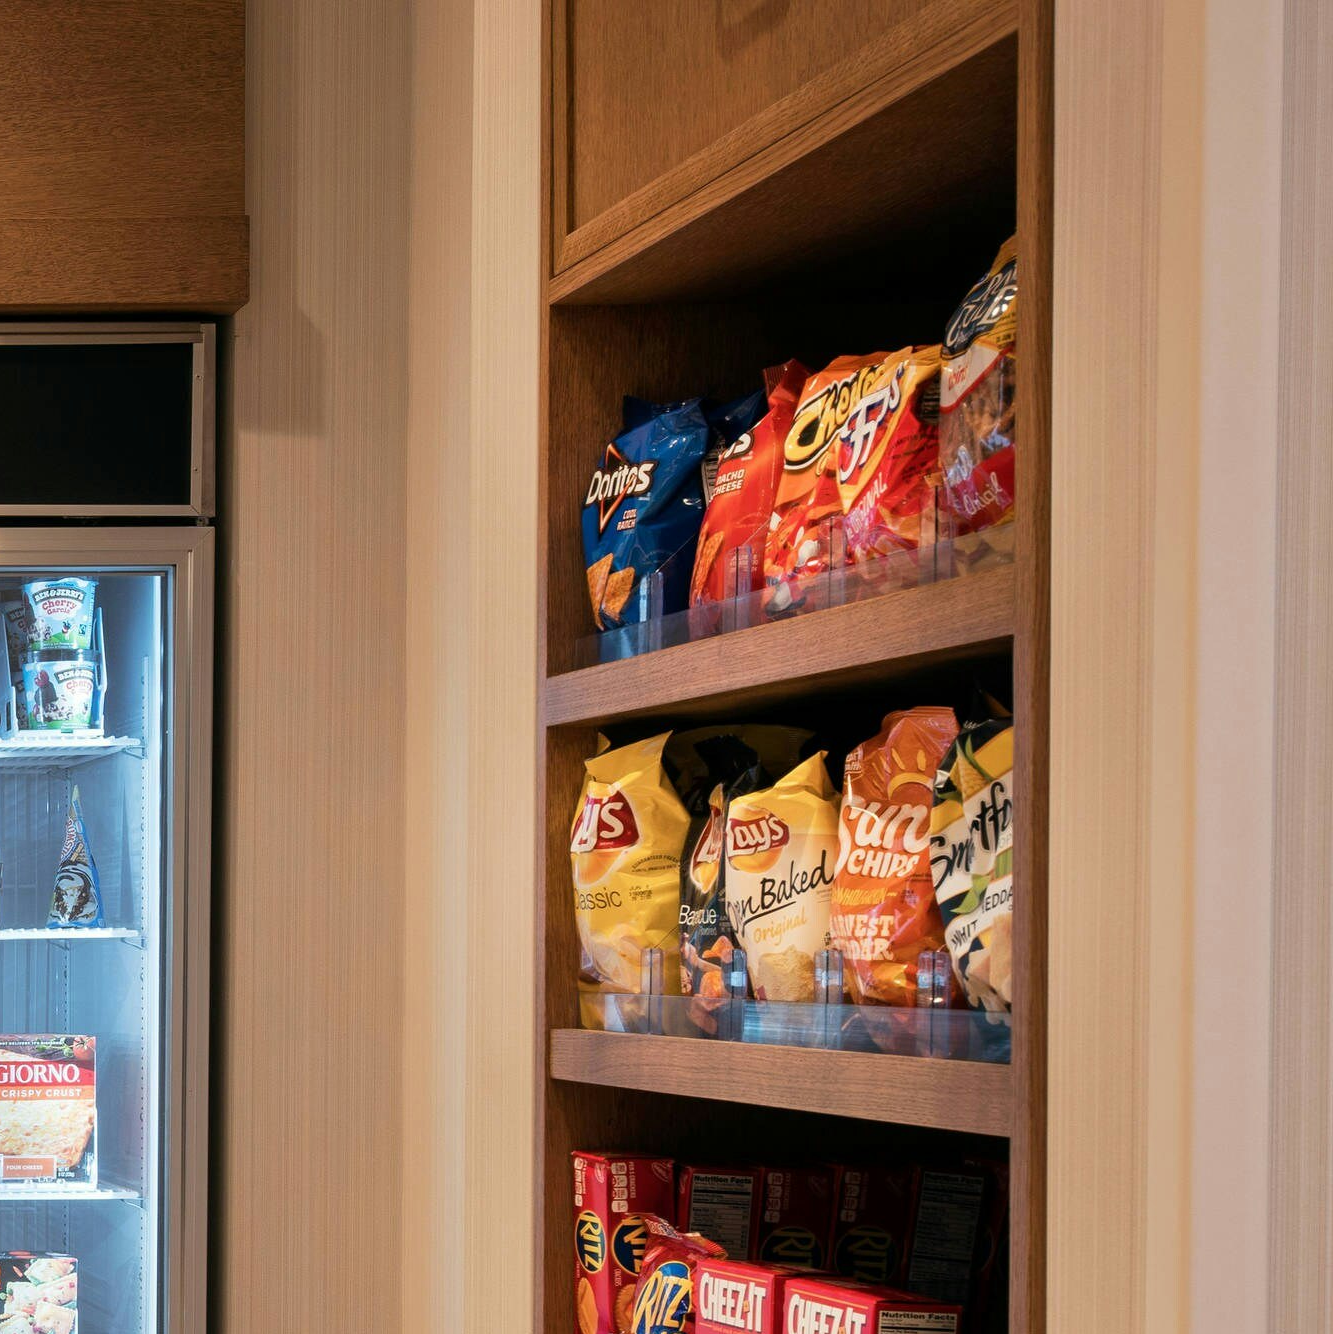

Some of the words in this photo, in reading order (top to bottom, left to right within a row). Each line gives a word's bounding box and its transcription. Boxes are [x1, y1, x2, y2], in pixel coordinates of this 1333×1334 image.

[585, 462, 655, 505] Doritos
[712, 480, 744, 497] CHEESE
[41, 599, 77, 609] Cherry
[727, 815, 785, 858] Lay's
[834, 795, 933, 881] Sun
[846, 849, 920, 879] CHIPS
[761, 850, 834, 909] Baked
[951, 920, 978, 948] WHIT
[1, 1089, 42, 1098] CRISPY
[46, 1089, 82, 1097] CRUST
[694, 1175, 728, 1184] Nutrition
[730, 1176, 752, 1185] Facts
[580, 1212, 603, 1272] RITZ
[882, 1311, 926, 1320] Nutrition
[928, 1313, 956, 1321] Facts
